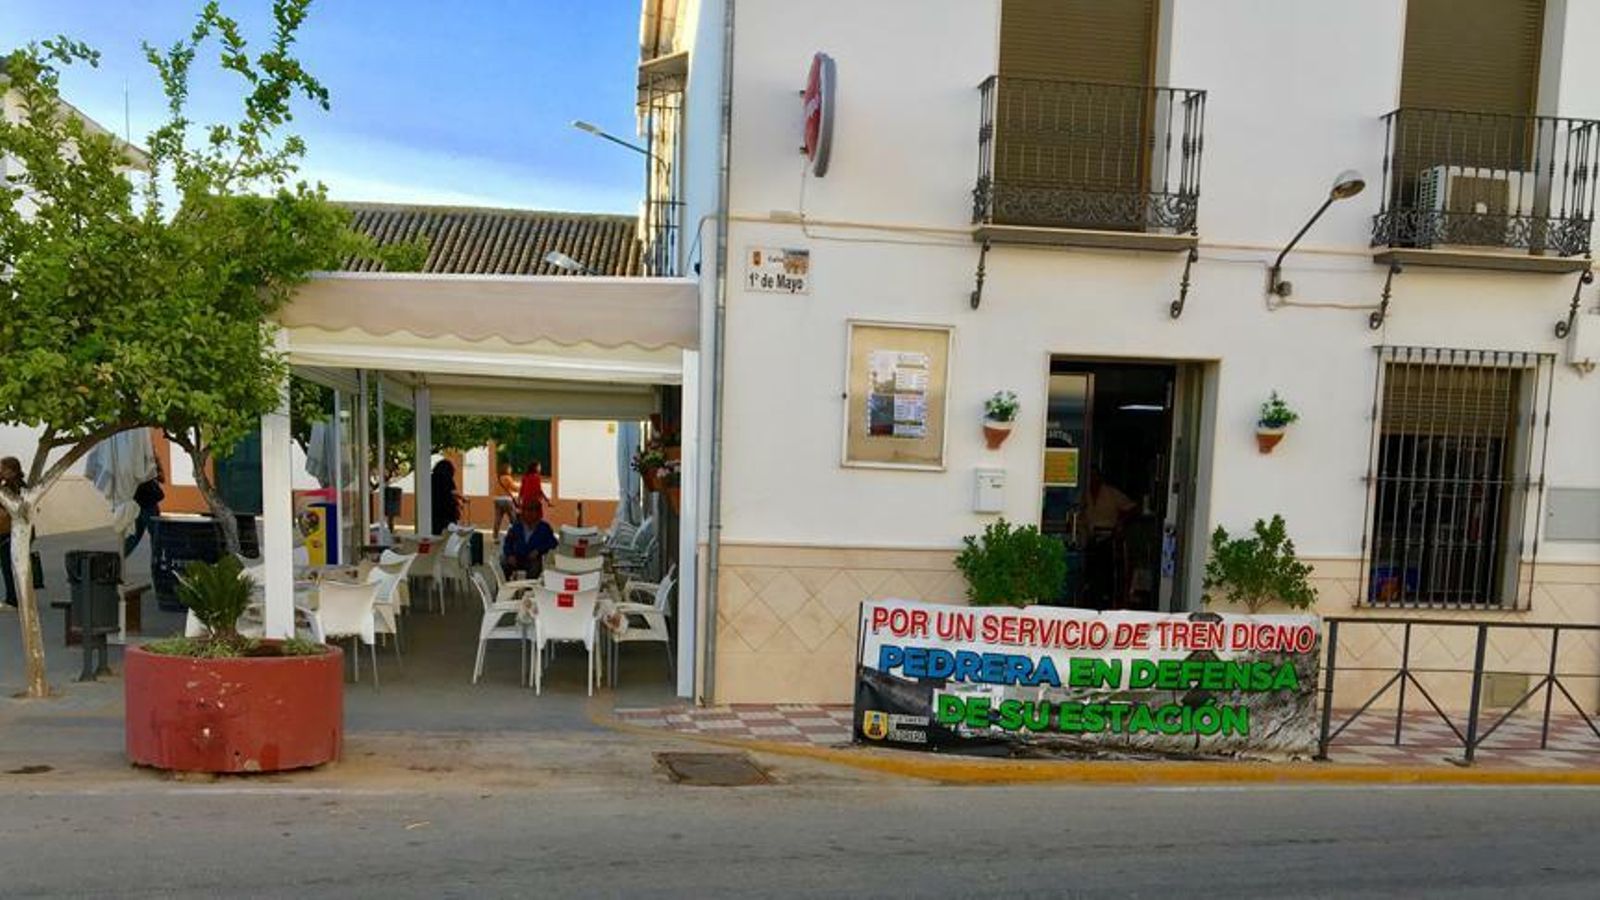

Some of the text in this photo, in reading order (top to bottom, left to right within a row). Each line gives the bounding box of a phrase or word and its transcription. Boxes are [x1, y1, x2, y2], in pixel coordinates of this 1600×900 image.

[761, 273, 774, 289] de
[776, 273, 804, 294] Mayo
[872, 606, 1318, 653] POR UN SERVICIO DE TREN DIGNO
[878, 644, 1299, 692] PEDRERA EN DEFENSA
[937, 693, 1250, 737] DE SU ESTACIÓN
